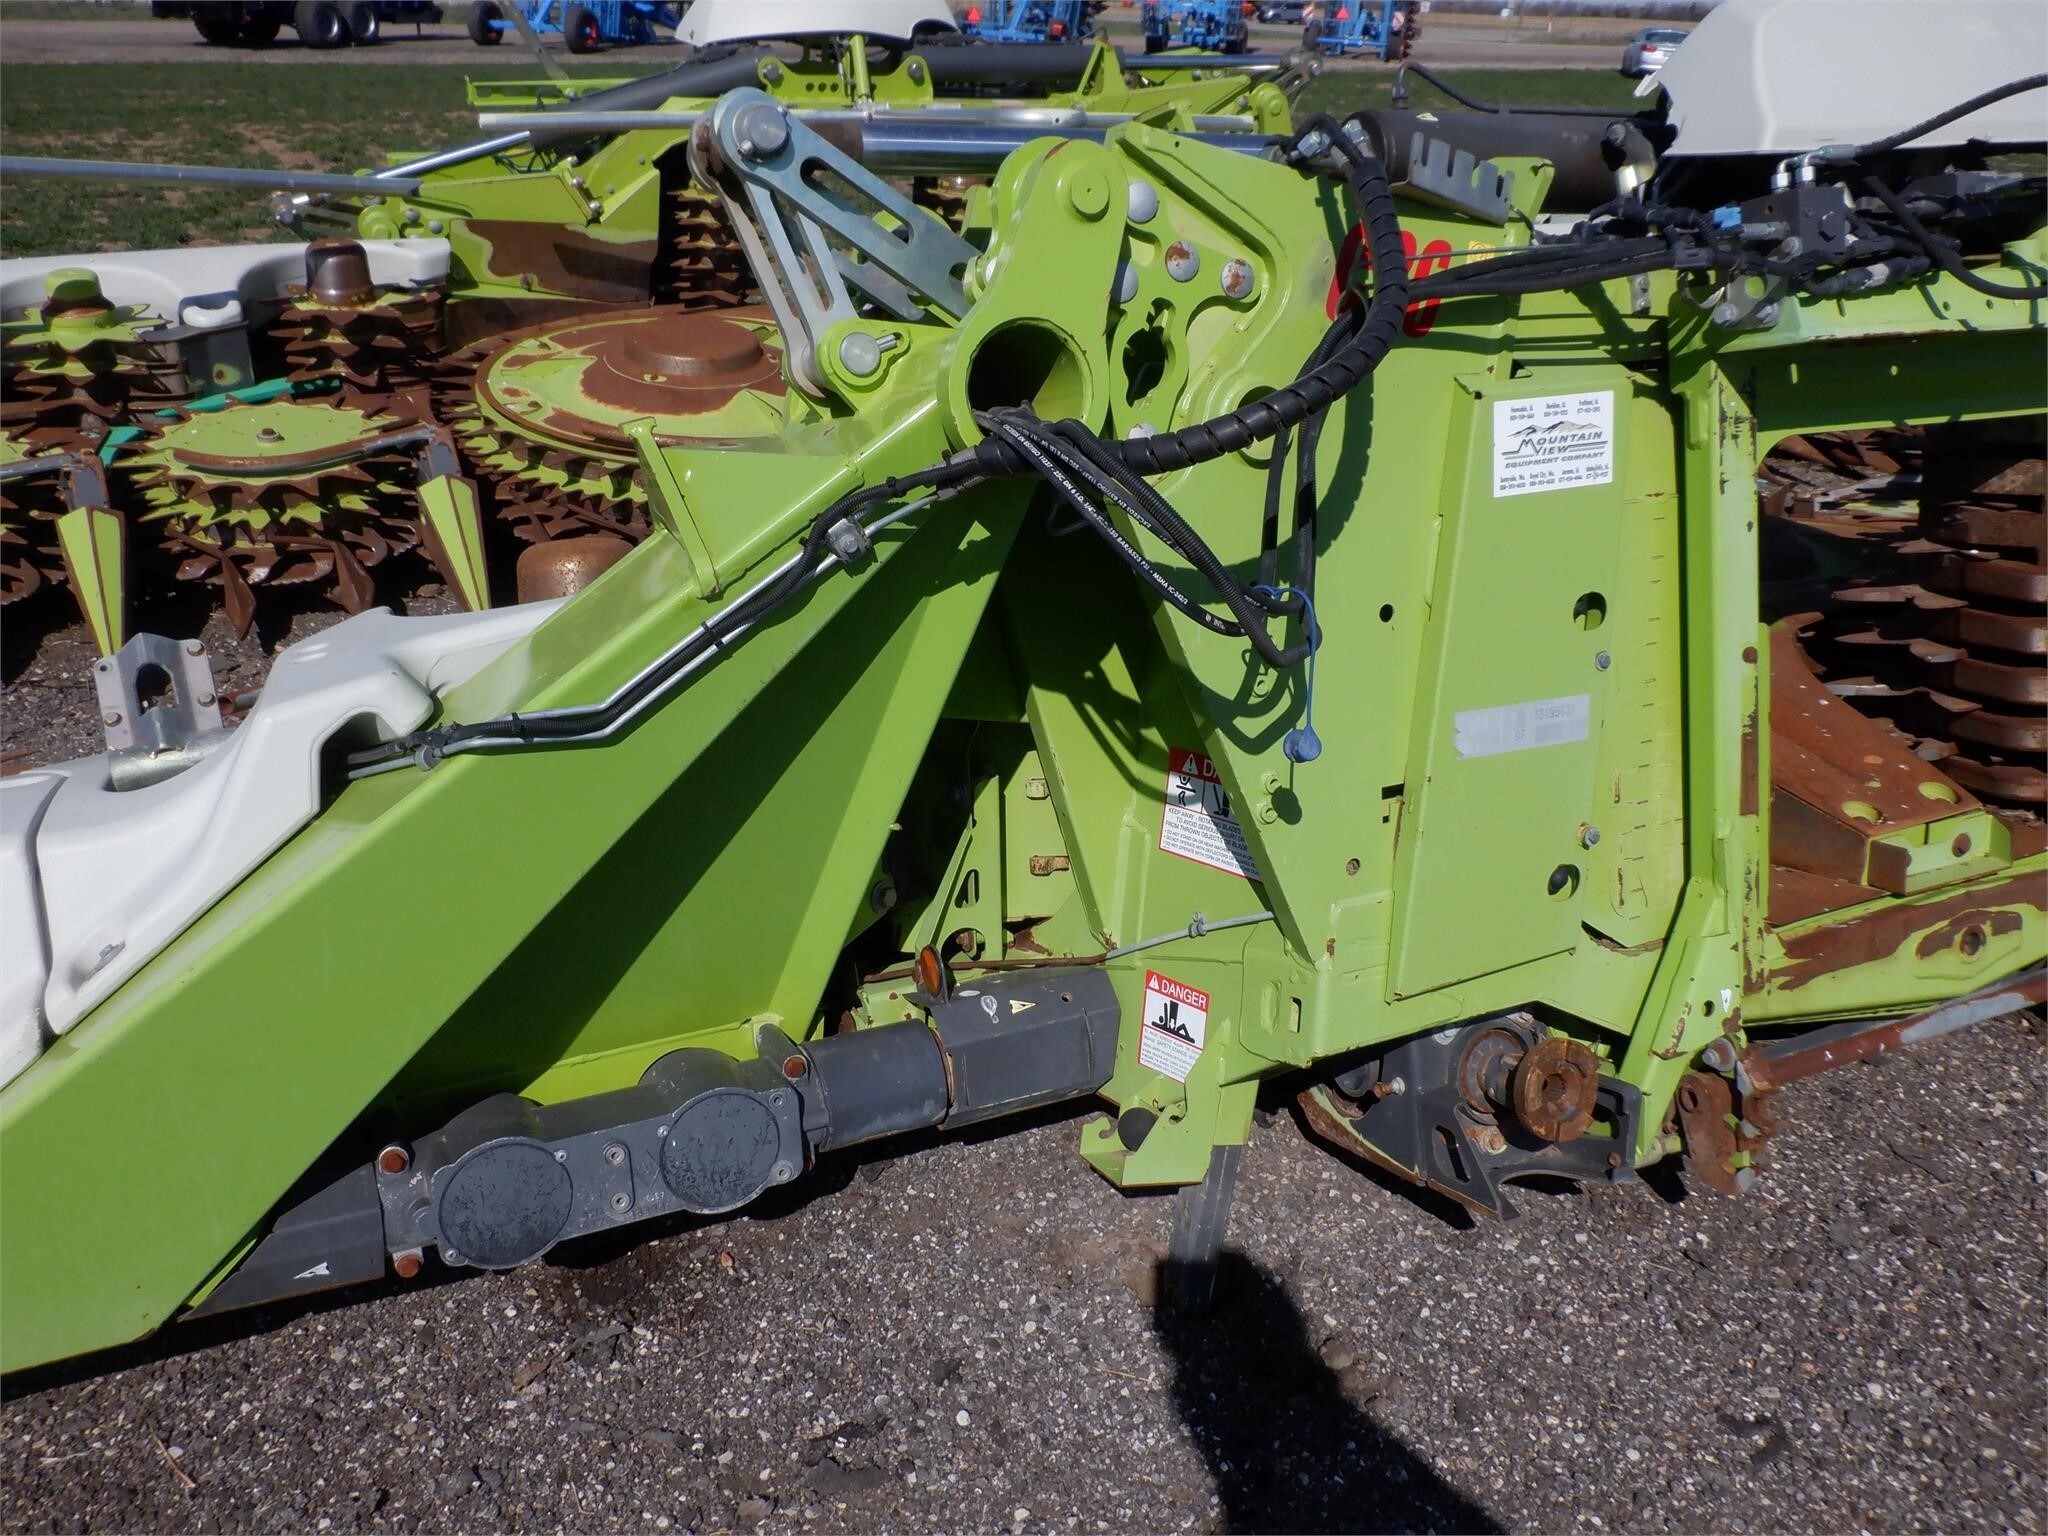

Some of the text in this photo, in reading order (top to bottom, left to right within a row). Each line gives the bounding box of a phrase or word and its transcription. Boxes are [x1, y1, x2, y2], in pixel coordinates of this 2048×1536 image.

[1518, 431, 1603, 452] MOUNTAIN
[1534, 445, 1570, 456] VIEW
[1505, 452, 1605, 469] EQUIPMENT COMPANY
[1152, 572, 1168, 588] MSHA
[1168, 807, 1180, 815] KEEP
[1181, 811, 1194, 819] AWAY
[1166, 820, 1179, 829] FROM
[1179, 824, 1200, 836] THROWN
[1183, 818, 1197, 828] AVOID
[1162, 980, 1206, 1009] DANGER
